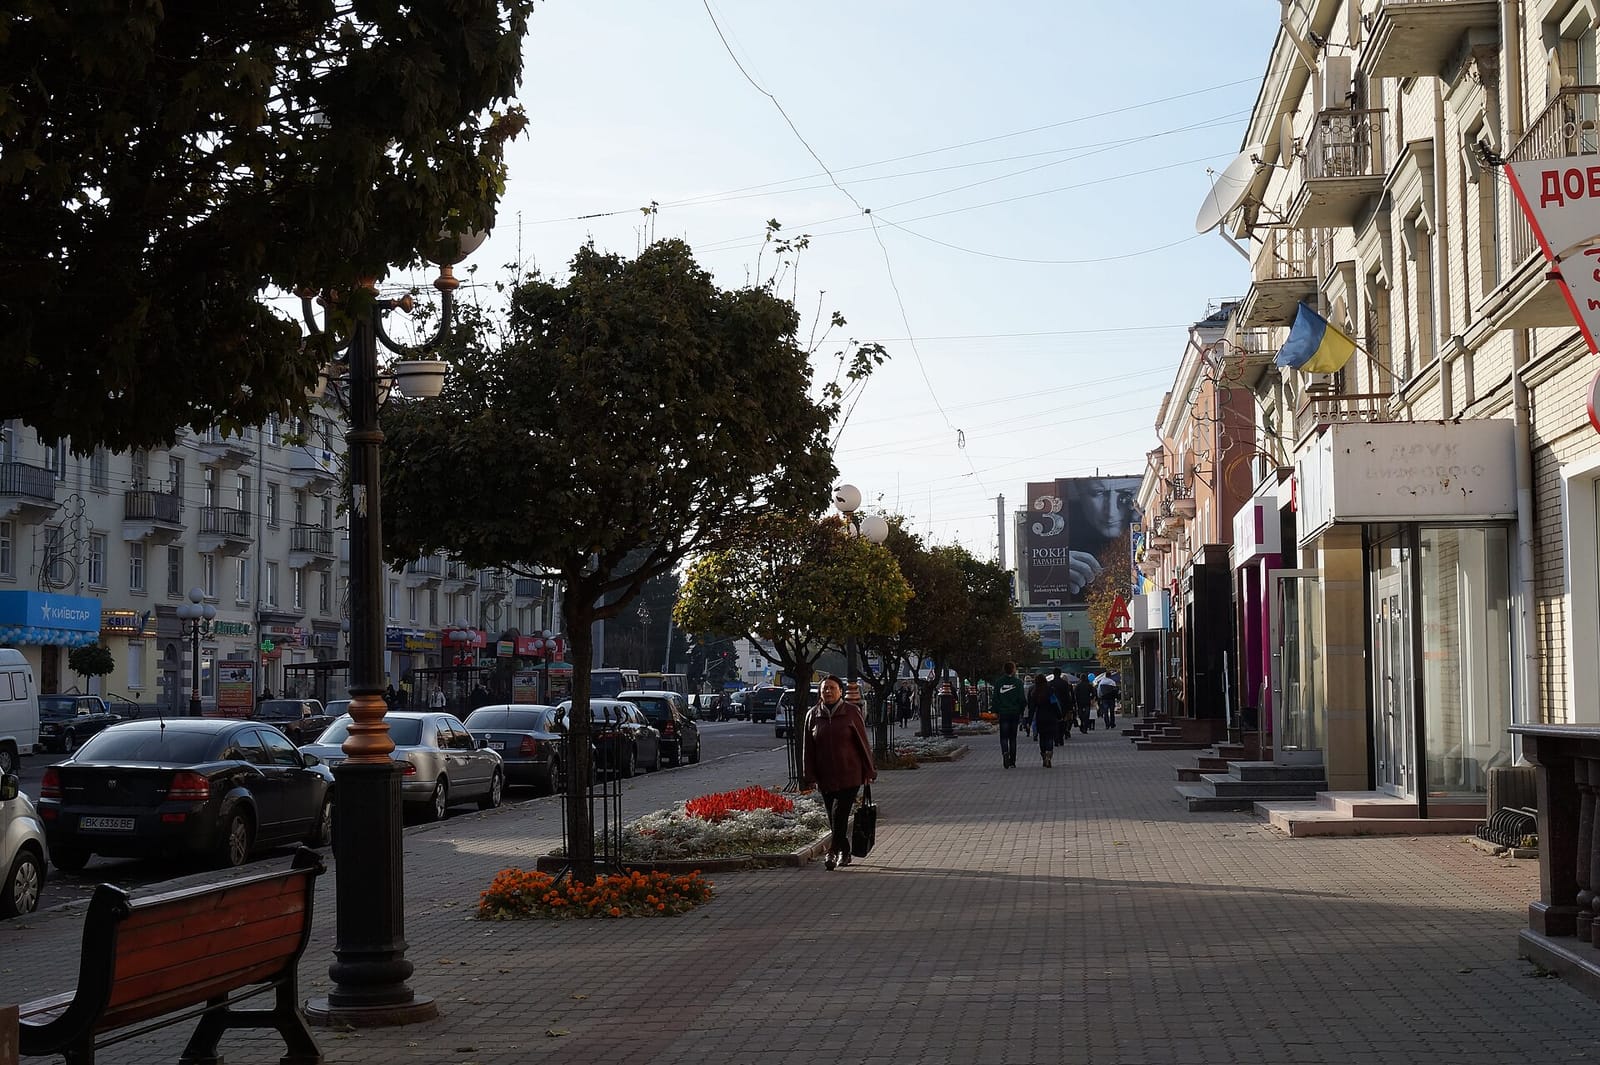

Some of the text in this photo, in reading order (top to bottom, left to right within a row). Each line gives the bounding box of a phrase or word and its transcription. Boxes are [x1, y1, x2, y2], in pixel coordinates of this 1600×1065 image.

[1032, 495, 1065, 537] 3
[1032, 547, 1066, 558] РОКИ
[51, 607, 90, 621] КИЇВСТАР
